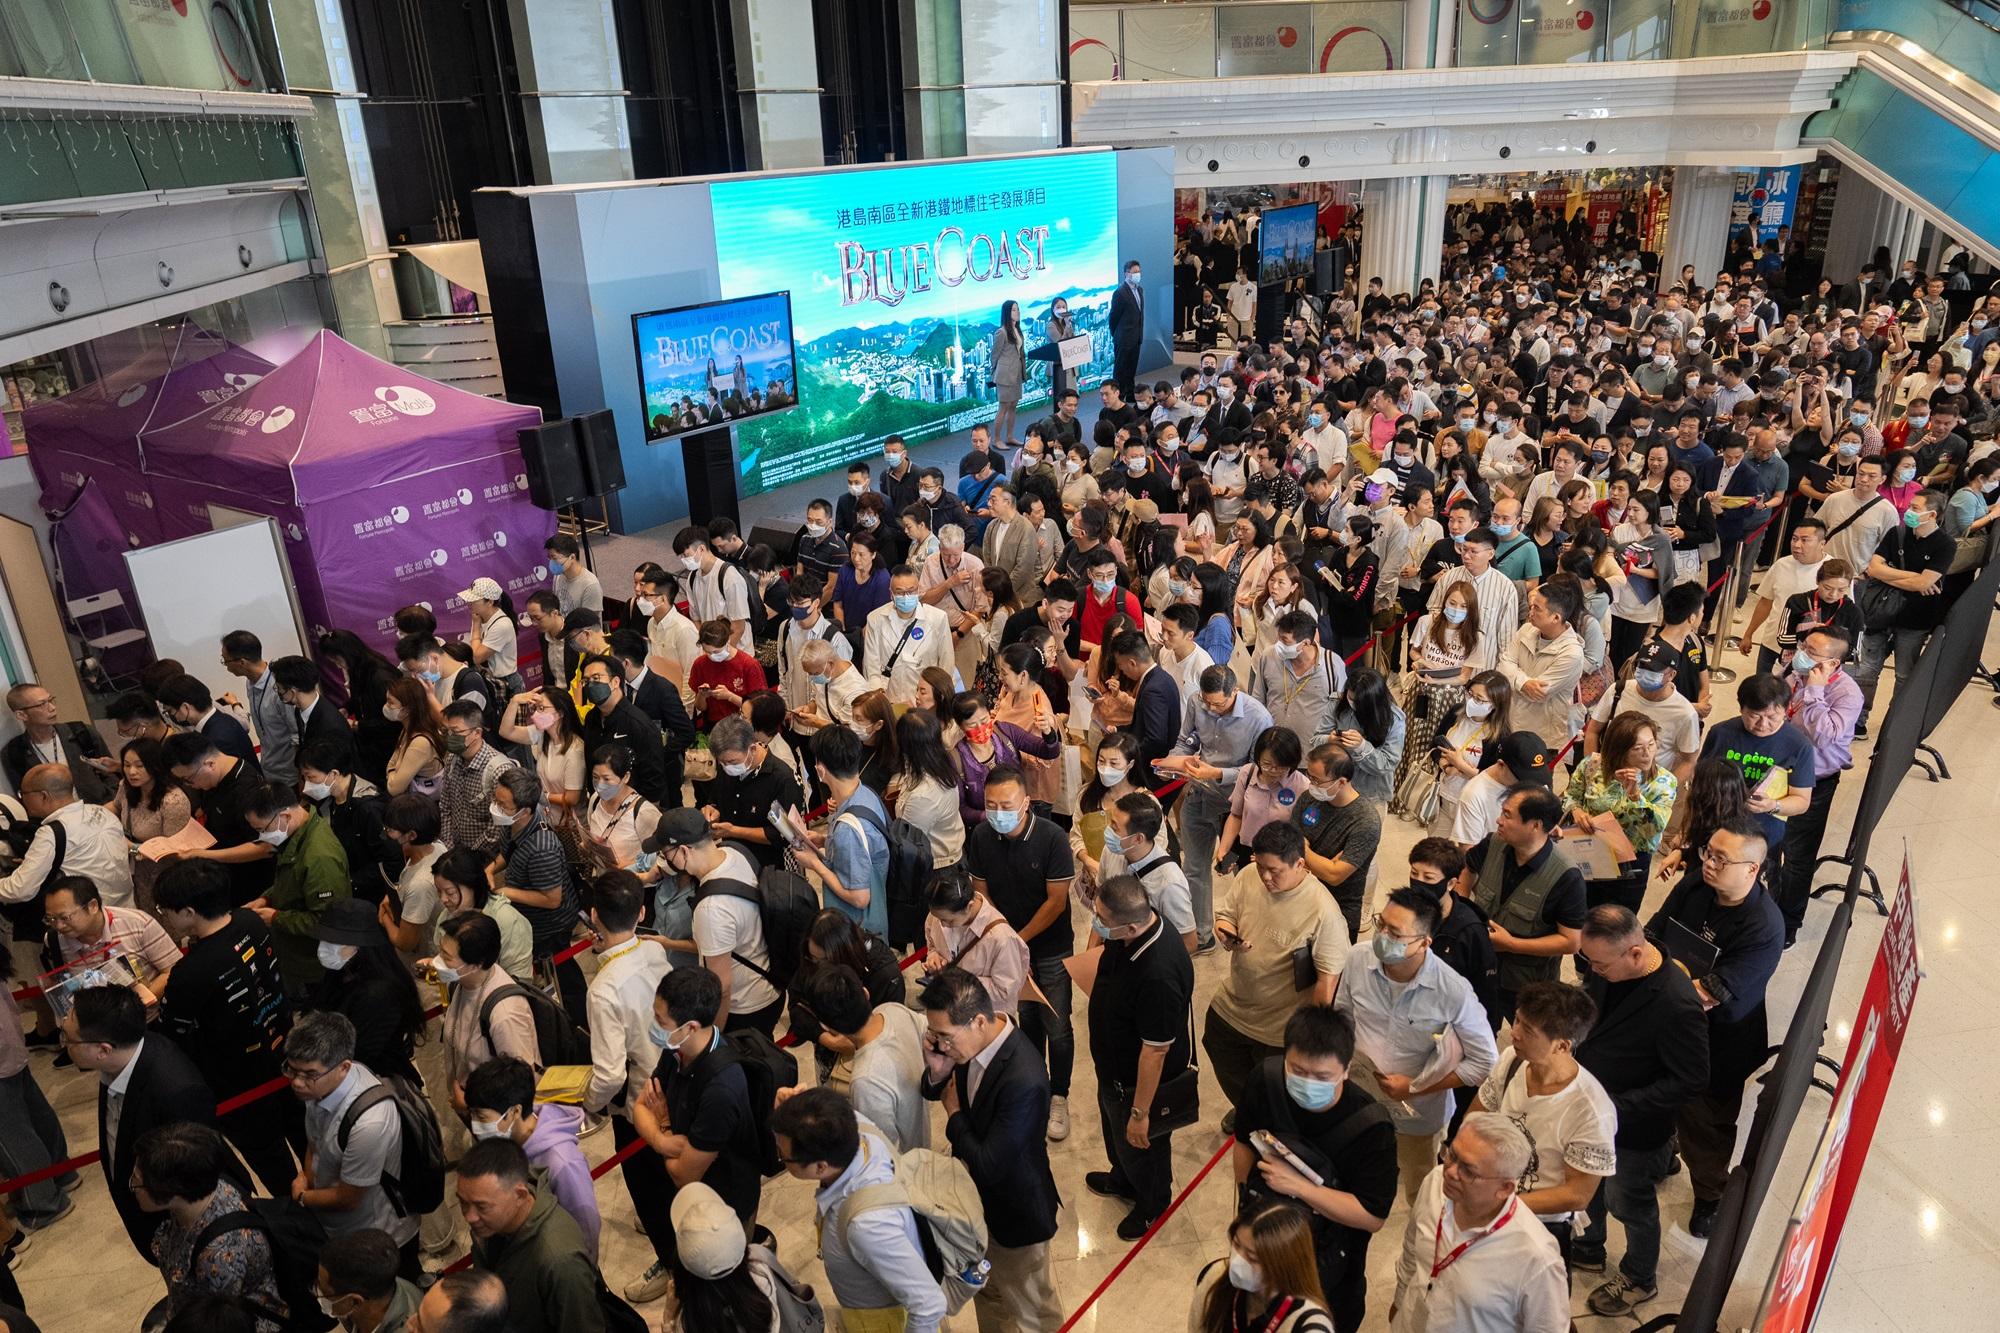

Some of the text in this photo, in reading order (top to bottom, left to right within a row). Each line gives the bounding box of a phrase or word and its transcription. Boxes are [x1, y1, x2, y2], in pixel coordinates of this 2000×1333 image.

[836, 187, 1046, 229] 港島南區全新港鐵地標住宅發展項目
[933, 225, 1049, 287] COAST
[710, 320, 781, 355] COAST
[349, 402, 394, 424] 置富
[394, 398, 435, 412] Malls
[370, 414, 400, 427] Fortune
[422, 496, 458, 515] 置富都會
[353, 515, 393, 535] 置富都會
[394, 558, 432, 577] 置富都會
[1427, 654, 1455, 666] PERSON
[1726, 749, 1774, 765] De père
